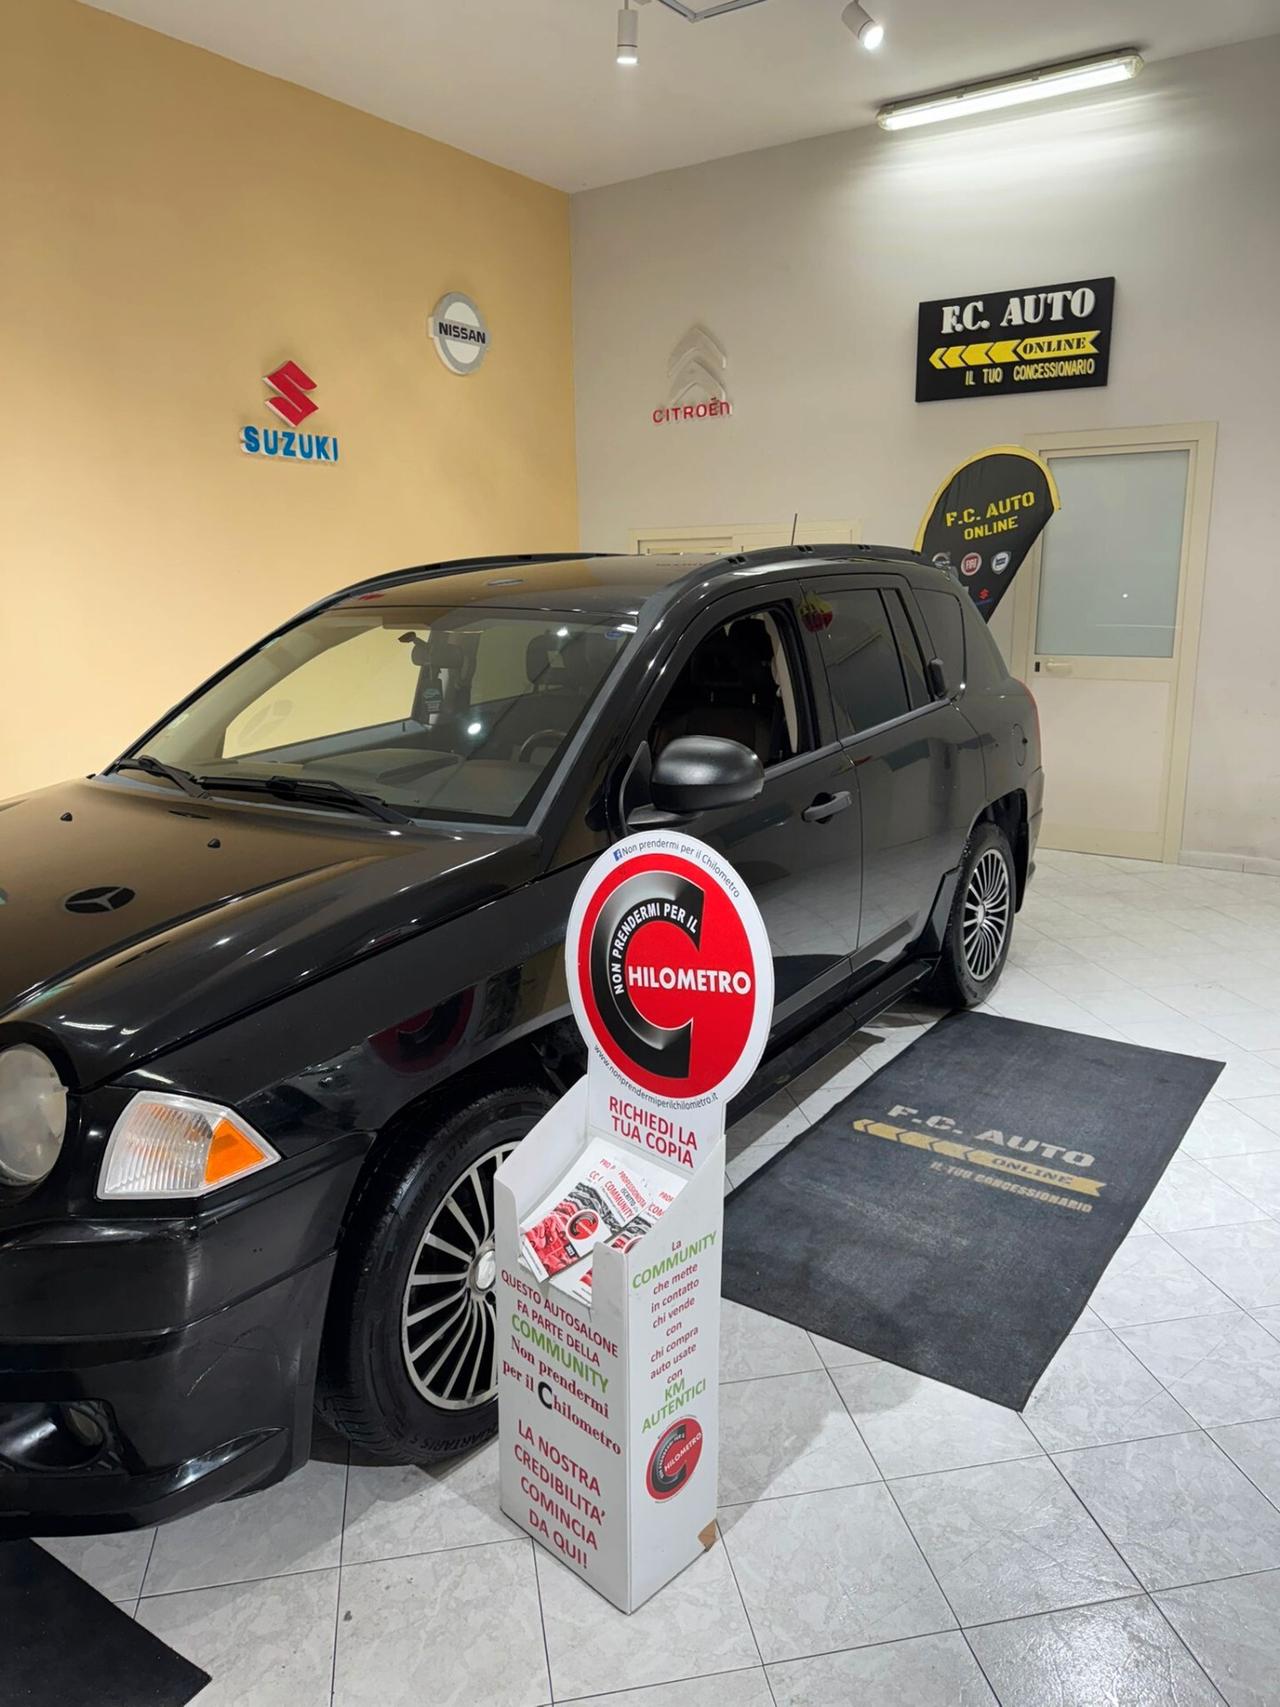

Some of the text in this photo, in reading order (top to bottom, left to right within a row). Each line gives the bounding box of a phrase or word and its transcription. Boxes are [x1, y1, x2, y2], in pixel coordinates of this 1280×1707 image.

[941, 287, 1096, 334] F.C. AUTO
[438, 322, 486, 344] NISSAN
[1022, 337, 1087, 355] ONLINE
[965, 357, 1095, 386] IL TUO CONCESSIONARIO
[242, 425, 338, 462] SUZUKI
[945, 491, 1035, 527] F.C. AUTO
[963, 515, 1019, 541] ONLINE
[622, 844, 637, 856] Non
[639, 839, 679, 851] prendermi
[681, 844, 695, 855] per
[696, 850, 702, 859] il
[702, 854, 740, 898] Chilometro
[611, 902, 698, 995] NON PRENDERMI PER IL
[594, 1045, 718, 1110] www.nonprendermiperilchilometro.it
[609, 1096, 697, 1150] RICHIEDI LA
[612, 1115, 694, 1168] TUA COPIA
[973, 1129, 1096, 1168] AUTO
[990, 1157, 1074, 1186] ONLINE
[605, 1180, 634, 1219] COMMUNITY
[973, 1173, 1093, 1214] CONCESSIONARIO
[632, 1231, 717, 1288] COMMUNITY
[672, 1240, 682, 1251] La
[651, 1279, 700, 1313] in contatto
[653, 1263, 698, 1295] che mette
[501, 1269, 618, 1358] QUESTO AUTOSALONE
[653, 1296, 695, 1328] chi vende
[666, 1321, 682, 1337] con
[511, 1314, 609, 1393] COMMUNITY
[517, 1300, 600, 1367] FA PARTE DELLA
[650, 1326, 699, 1362] chi compra
[511, 1335, 609, 1419] Non prendermi
[650, 1343, 697, 1379] auto usate
[667, 1368, 683, 1384] con
[503, 1360, 621, 1455] per il Chilometro
[642, 1379, 706, 1433] AUTENTICI
[664, 1377, 685, 1402] KM
[518, 1419, 601, 1496] LA NOSTRA
[514, 1444, 605, 1526] CREDIBILITA'
[521, 1476, 598, 1550] COMINCIA
[529, 1508, 588, 1569] DA QUI!
